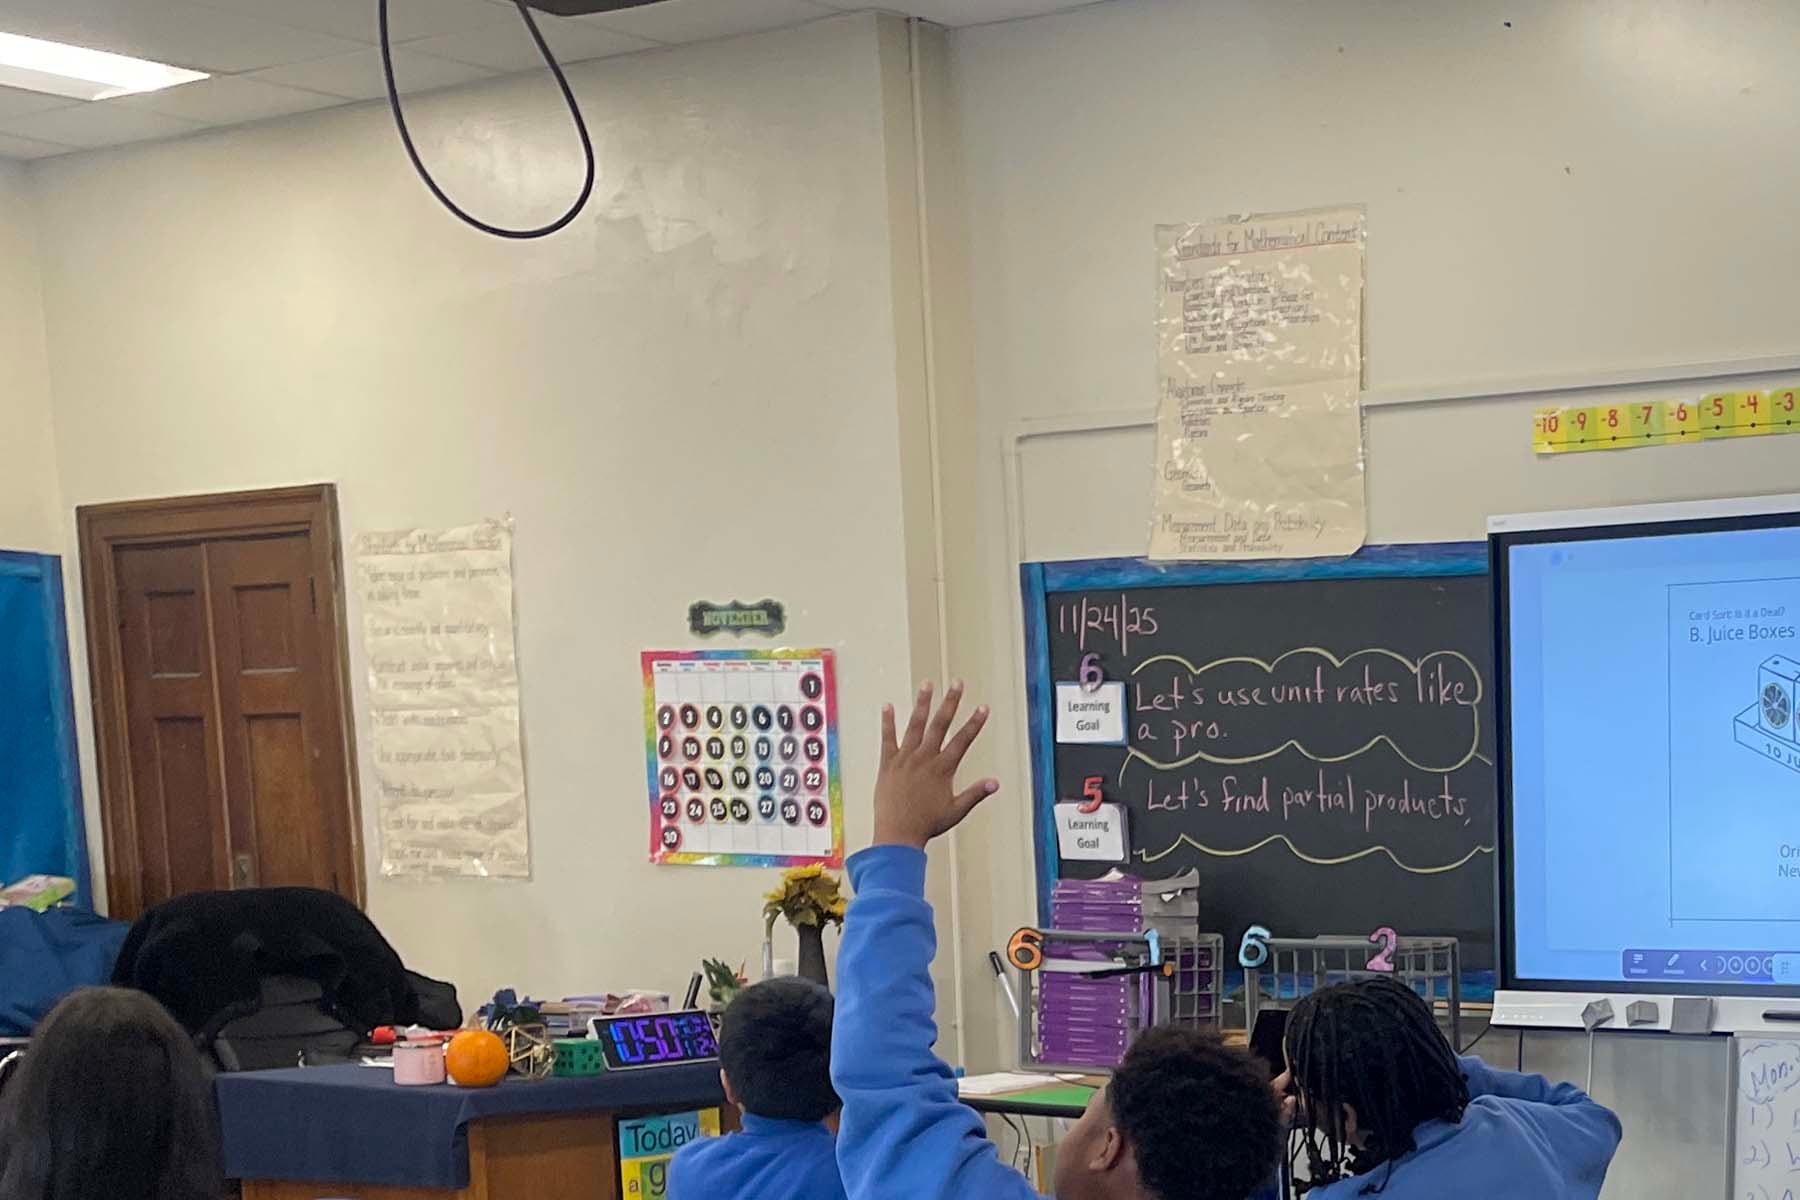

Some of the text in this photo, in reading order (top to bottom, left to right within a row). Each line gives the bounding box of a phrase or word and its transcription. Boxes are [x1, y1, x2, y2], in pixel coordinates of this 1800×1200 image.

[1535, 416, 1559, 434] -10
[1570, 412, 1587, 431] -9
[1601, 408, 1618, 428] -8
[1636, 405, 1653, 425] -7
[1669, 403, 1687, 422] -6
[1705, 398, 1724, 416] -5
[1740, 395, 1758, 413] -4
[1776, 392, 1794, 411] -3
[703, 610, 768, 626] NOVEMBER
[1058, 593, 1159, 656] 11/24/25
[1689, 624, 1796, 645] B. Juice Boxes
[1079, 652, 1104, 692] 6
[809, 680, 816, 692] 1
[1135, 658, 1475, 713] Let's use unit rates like
[662, 711, 816, 725] 2 3 4 5 6 7 8
[1068, 701, 1111, 719] Learning
[1075, 719, 1100, 732] Goal
[1138, 718, 1228, 755] a pro.
[662, 740, 820, 756] 9 10 11 12 13 14 15
[1765, 742, 1783, 760] 10
[663, 771, 821, 787] 16 17 18 19 20 21 22
[1080, 776, 1104, 813] 5
[1147, 775, 1208, 812] Let's
[1221, 775, 1270, 814] find
[1283, 768, 1354, 816] partial
[662, 801, 823, 819] 23 24 25 26 27 28 29
[664, 830, 677, 844] 30
[1068, 819, 1109, 838] Learning
[1076, 837, 1100, 851] Goal
[1007, 926, 1160, 971] 6 1
[1239, 924, 1398, 972] 6 2
[1751, 1063, 1794, 1097] Mon.
[1750, 1106, 1774, 1130] 1)
[625, 1119, 698, 1153] Today
[1742, 1140, 1772, 1169] 2)
[629, 1179, 639, 1193] a
